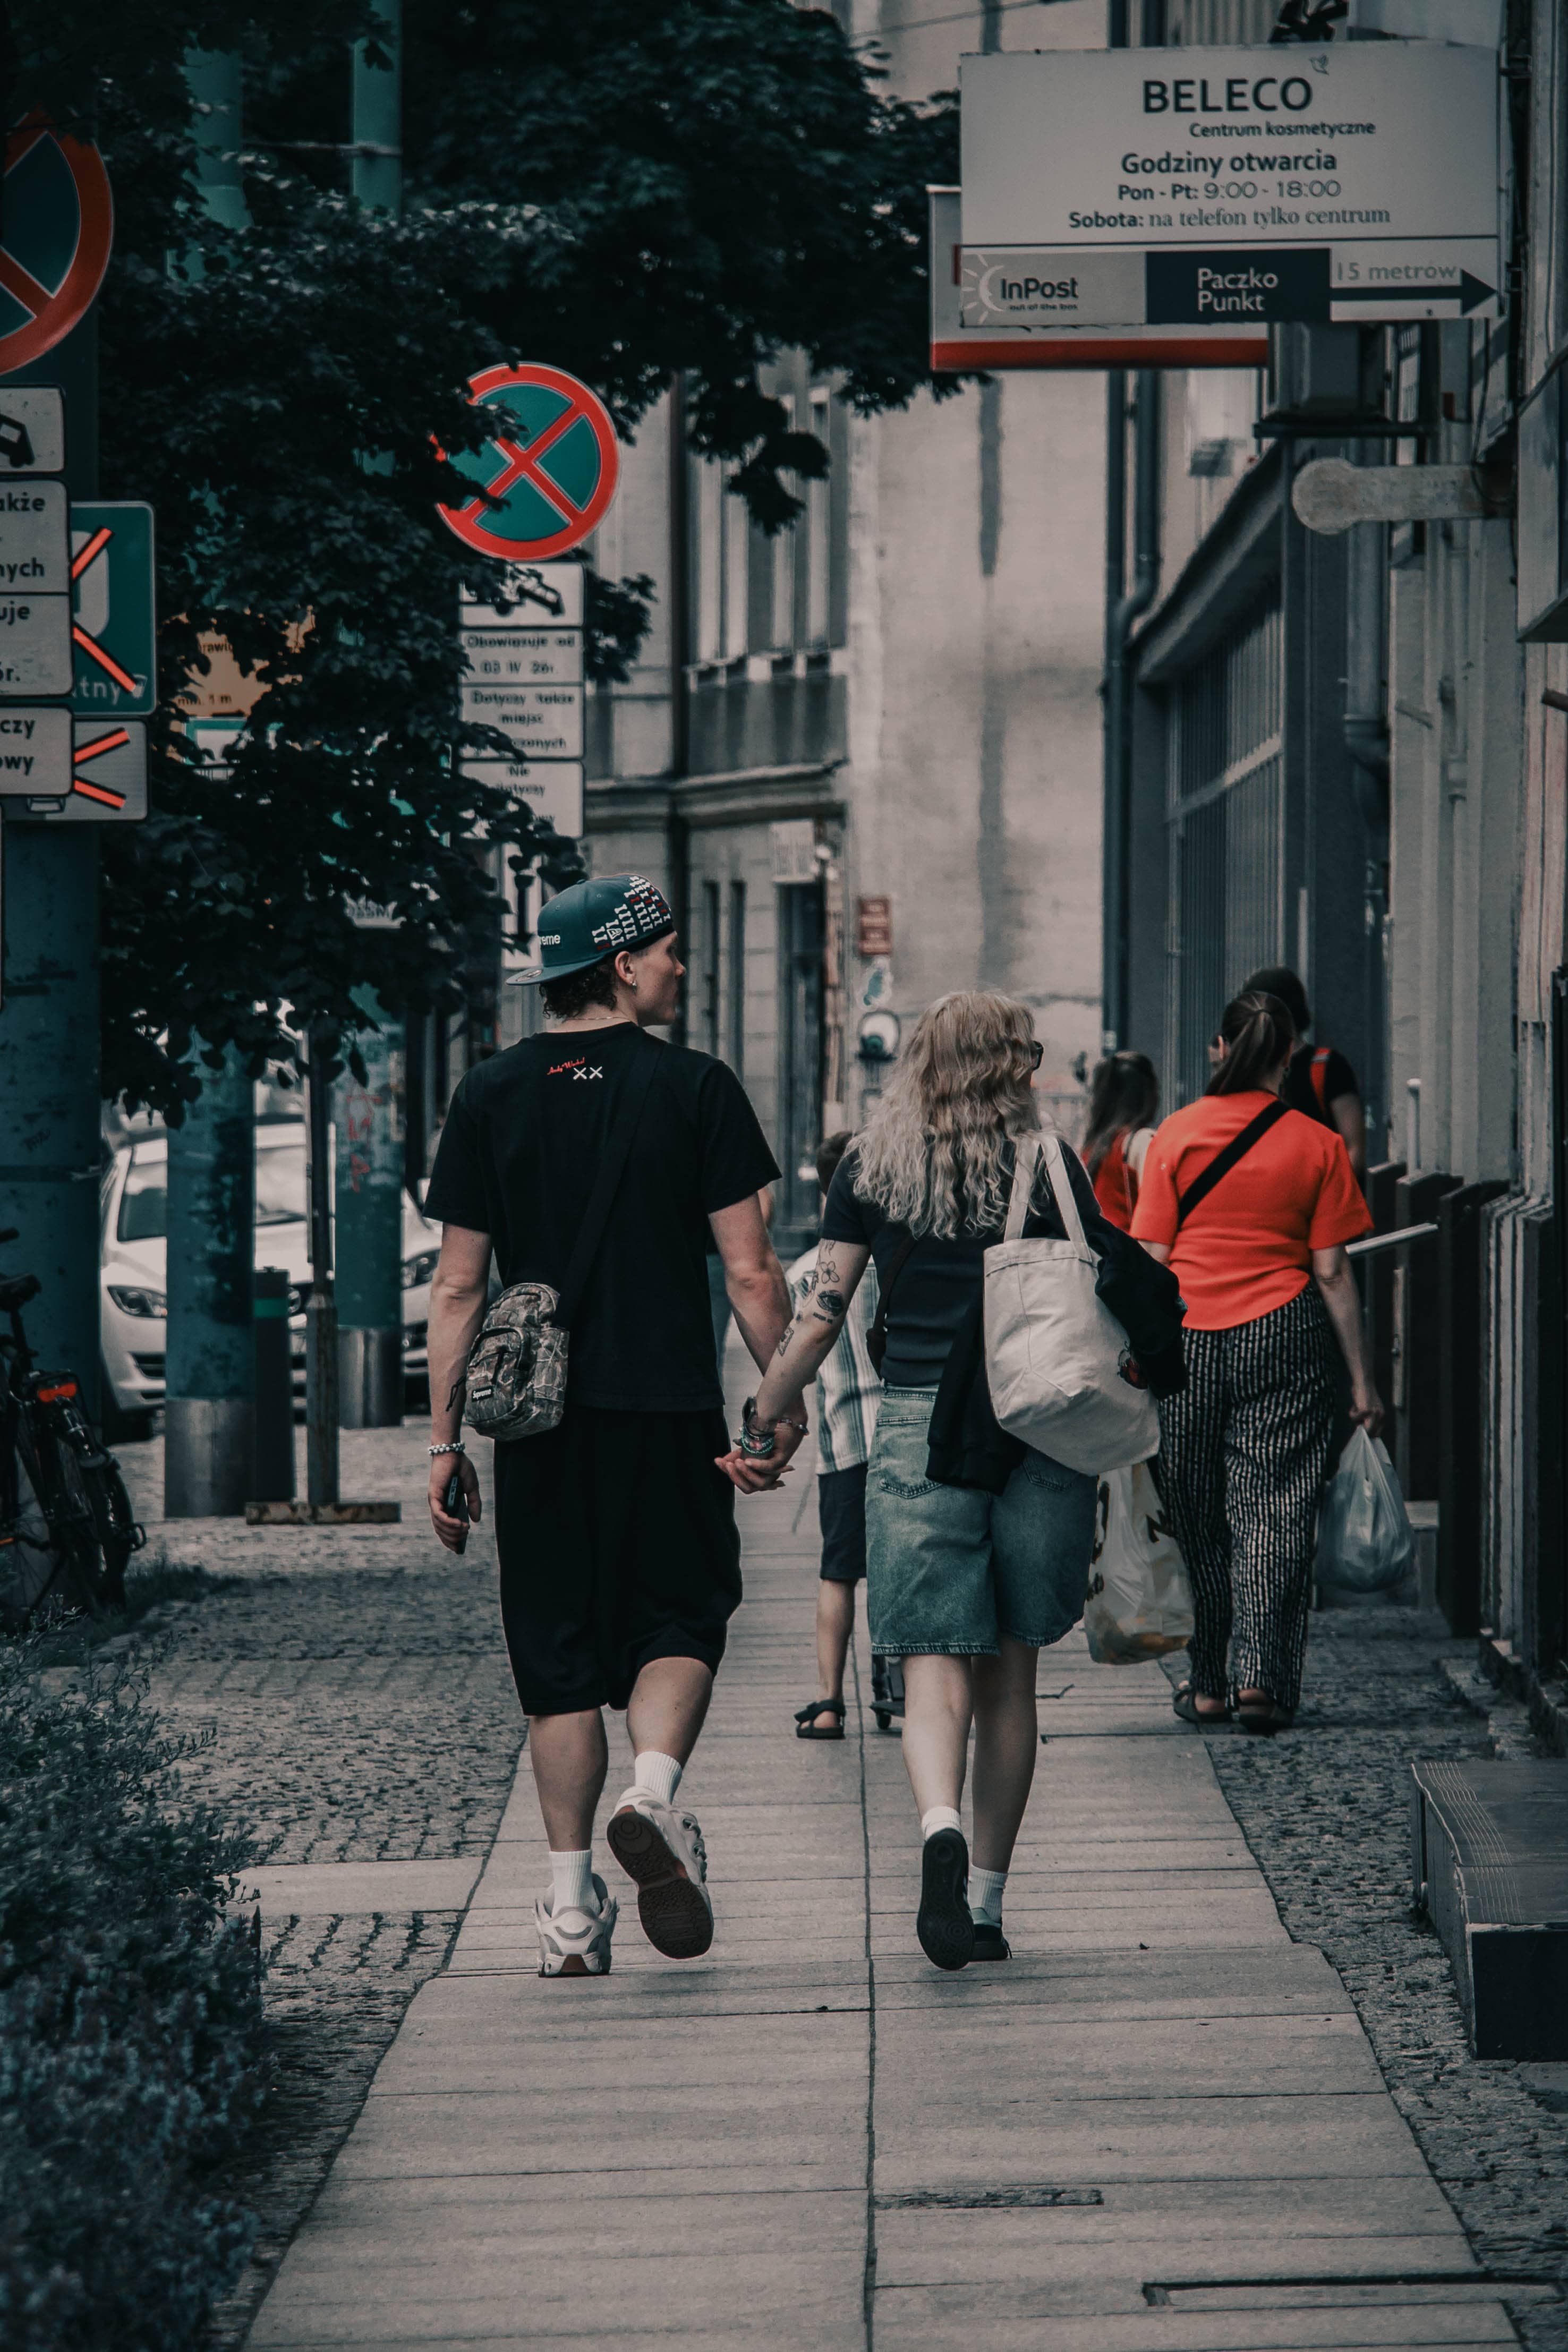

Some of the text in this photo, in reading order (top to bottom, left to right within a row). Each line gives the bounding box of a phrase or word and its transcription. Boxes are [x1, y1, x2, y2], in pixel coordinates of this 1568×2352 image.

[1143, 77, 1313, 113] BELECO
[1189, 121, 1376, 139] Centrum kosmetyczne
[1121, 149, 1337, 178] Godziny otwarcia
[1118, 184, 1155, 200] Pon
[1171, 183, 1198, 200] Pt:
[1204, 181, 1258, 200] 9:00
[1277, 179, 1342, 198] 18:00
[1068, 206, 1391, 229] Sobota: na telefon tylko centrum
[1197, 266, 1279, 289] Paczko
[1337, 261, 1360, 282] 15
[1001, 277, 1079, 300] InPost
[1197, 290, 1266, 312] Punkt
